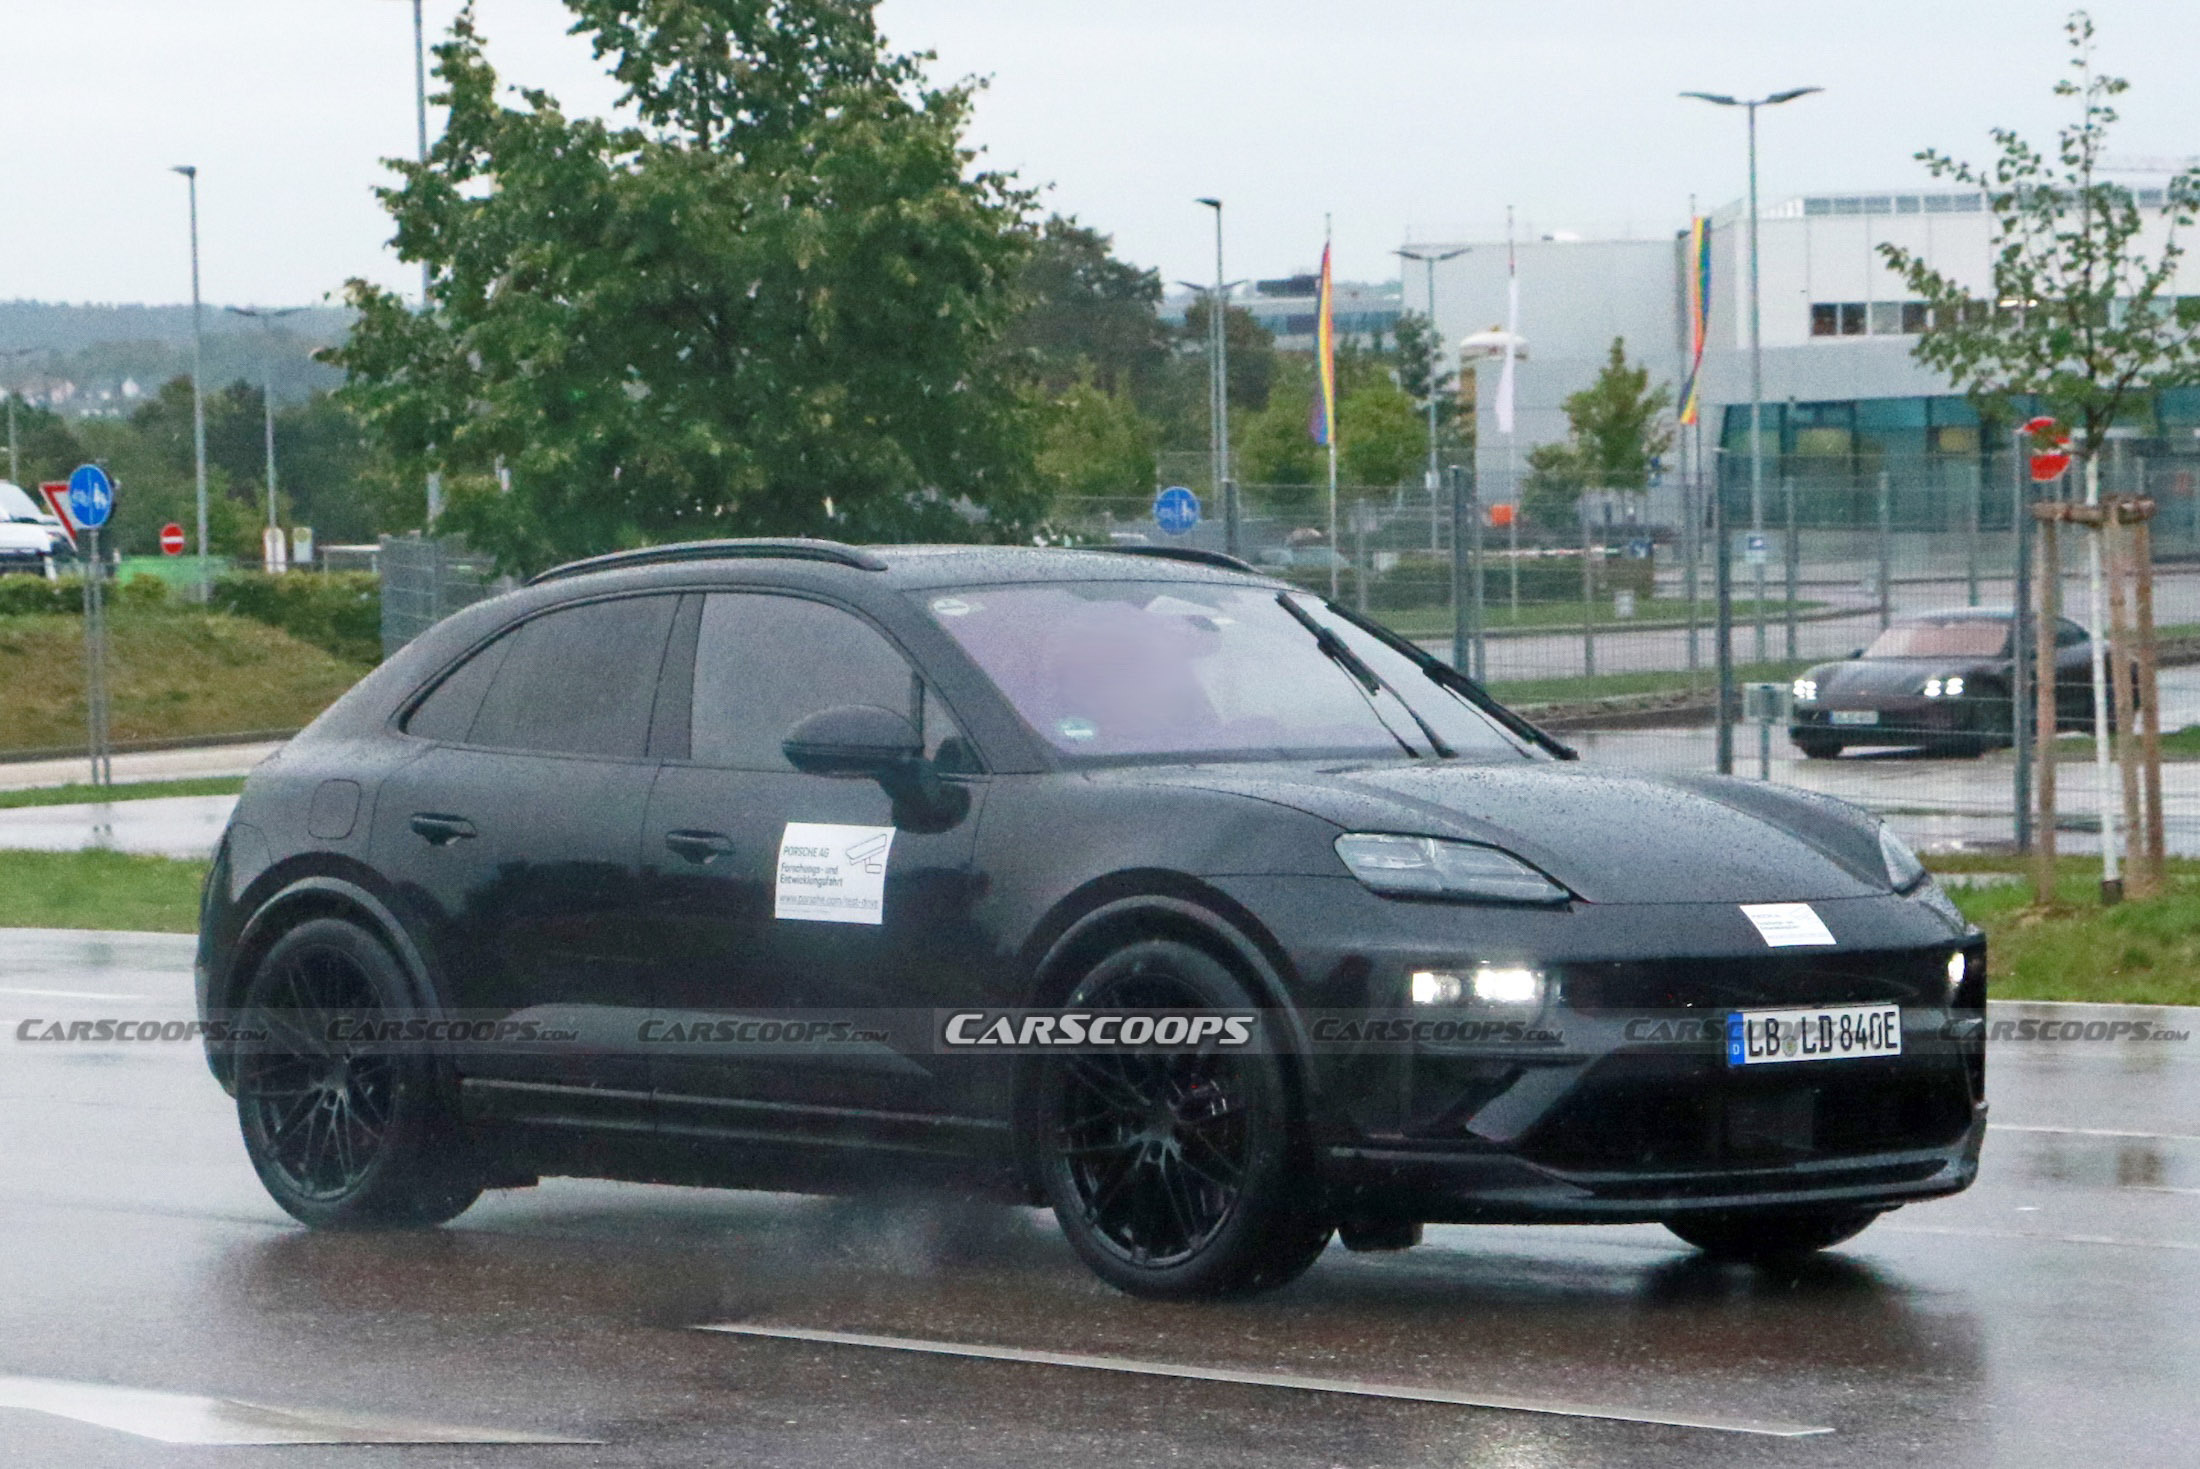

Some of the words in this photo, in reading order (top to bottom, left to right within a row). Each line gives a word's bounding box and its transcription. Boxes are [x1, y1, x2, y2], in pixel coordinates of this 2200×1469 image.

[783, 845, 817, 857] PORSCHE
[819, 847, 829, 857] AG
[825, 865, 839, 875] und
[1747, 1018, 1780, 1058] LB
[1801, 1015, 1833, 1053] LD
[1840, 1011, 1898, 1052] 840E
[1732, 1043, 1740, 1056] D
